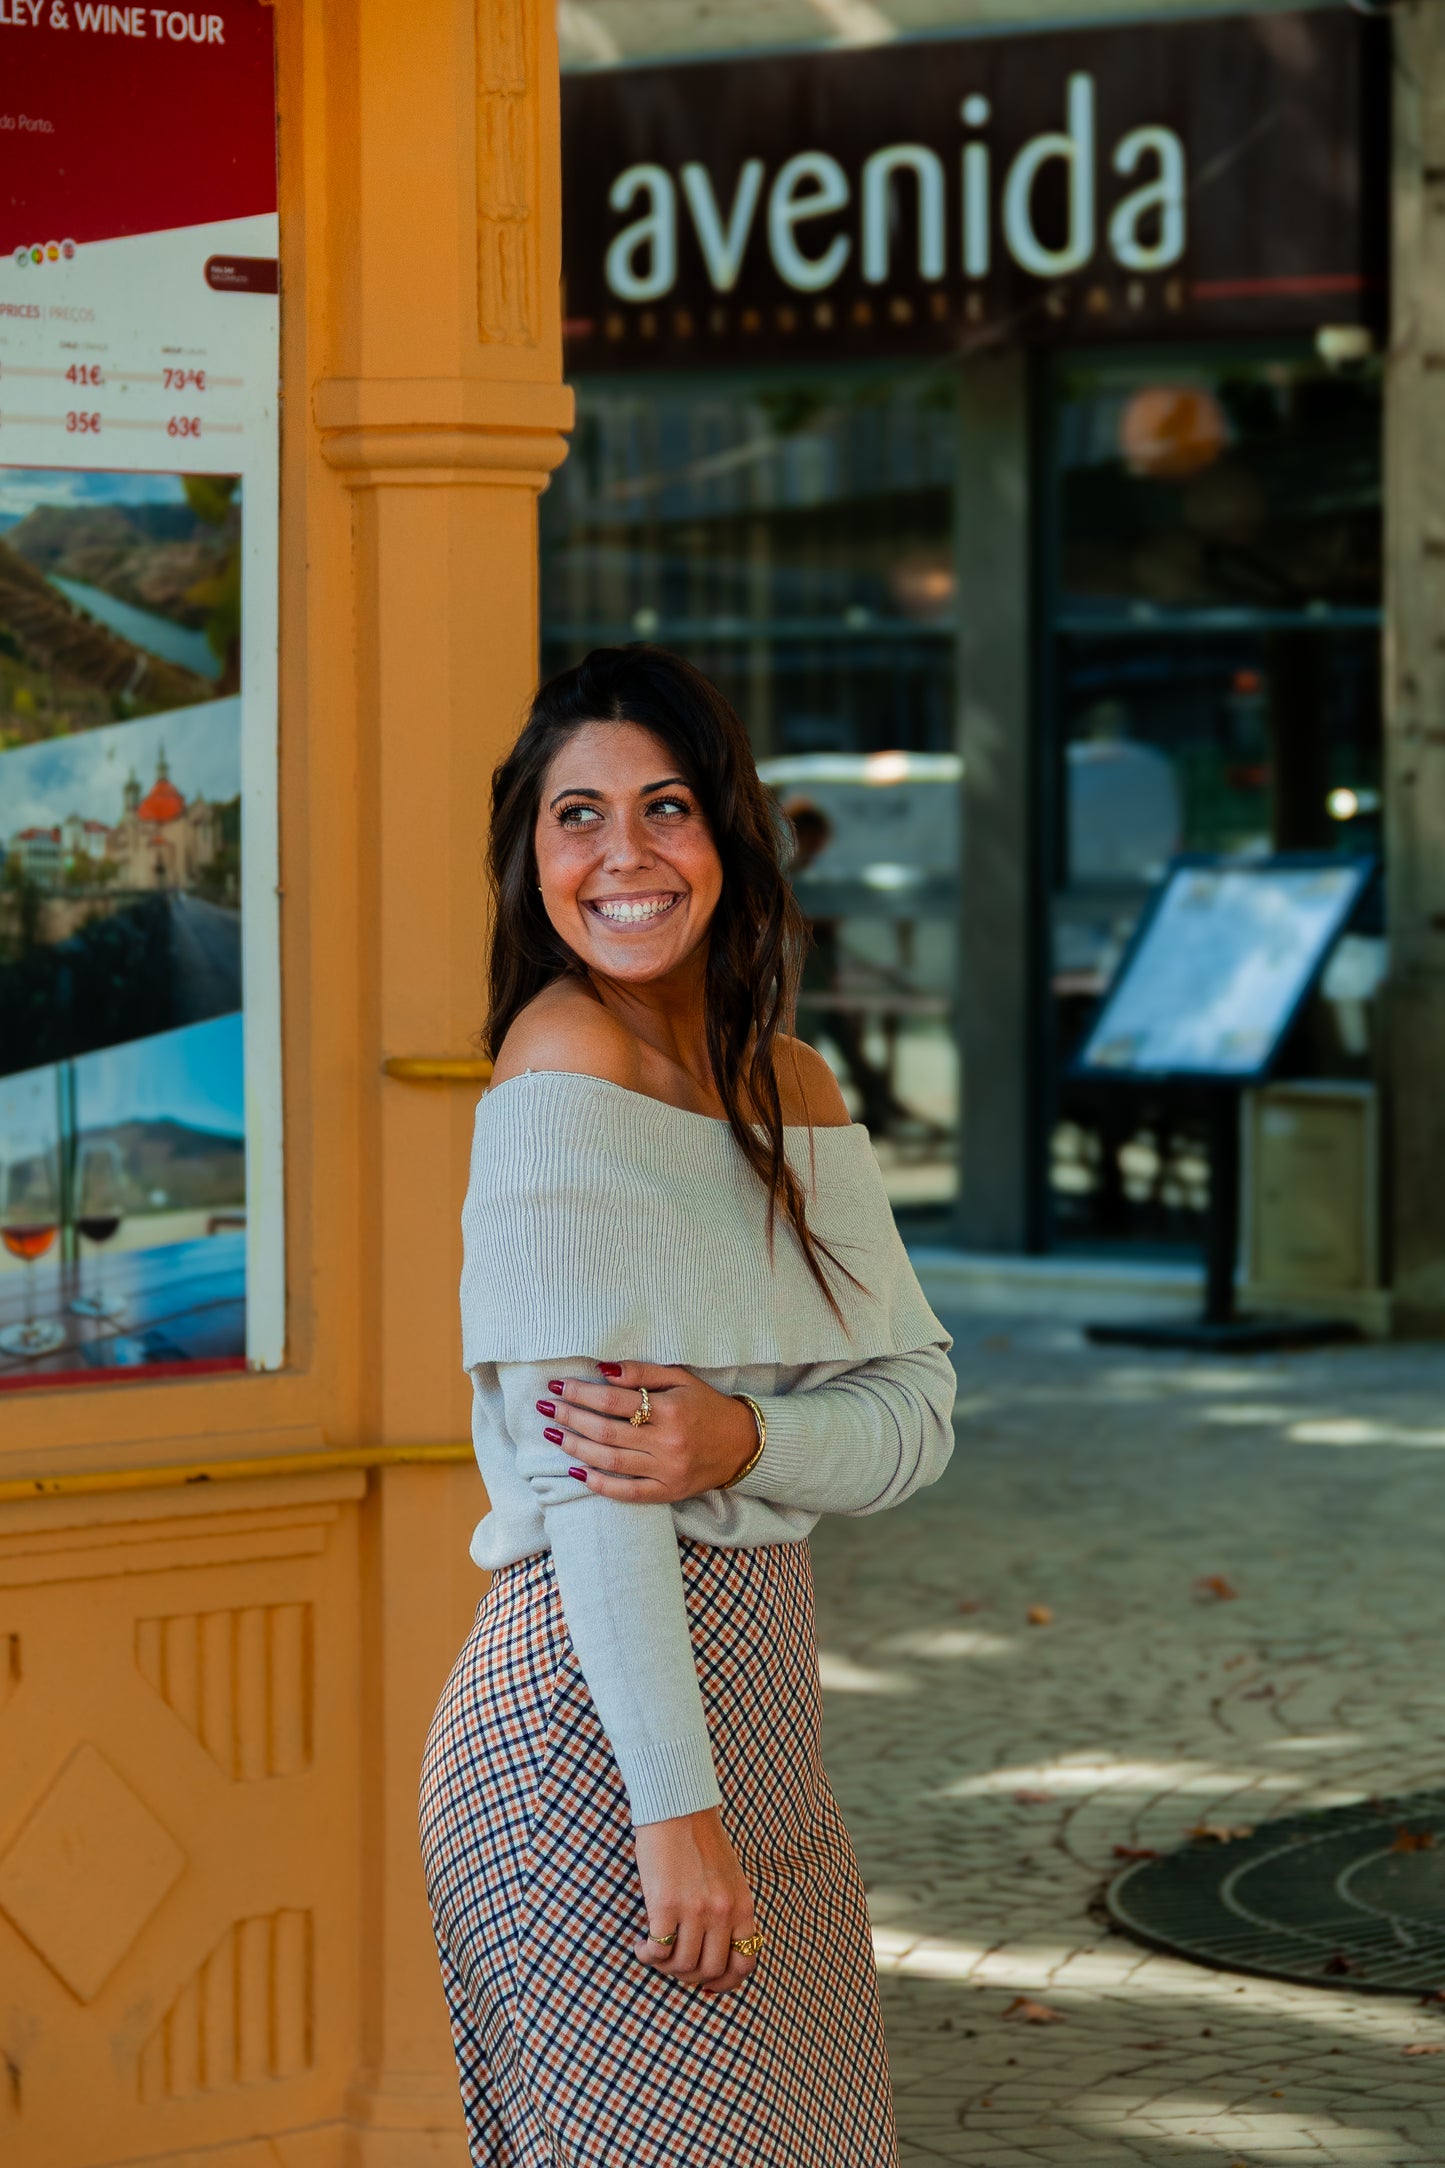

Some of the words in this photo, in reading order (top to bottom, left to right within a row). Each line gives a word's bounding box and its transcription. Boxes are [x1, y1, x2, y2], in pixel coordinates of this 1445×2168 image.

[49, 0, 70, 29] &
[73, 1, 147, 37] WINE
[150, 9, 224, 44] TOUR
[18, 114, 55, 133] Porto.
[605, 72, 1187, 302] avenida
[0, 304, 40, 319] PRICES
[49, 306, 95, 323] PREÇOS
[65, 364, 101, 386] 41€
[66, 411, 101, 433] 35€
[167, 416, 201, 438] 63€
